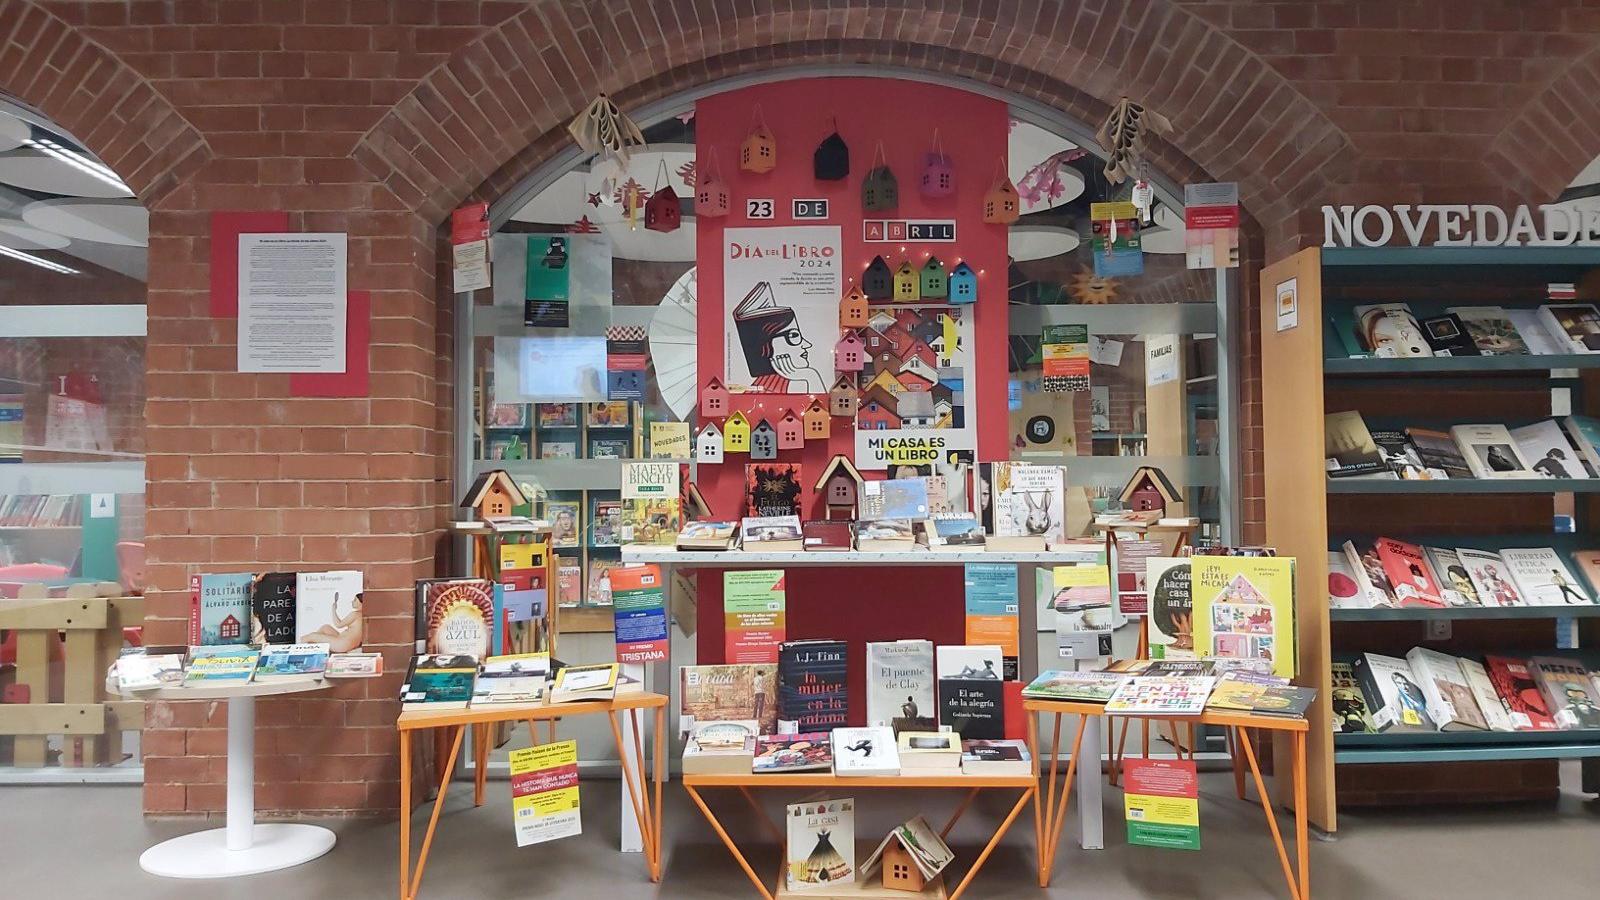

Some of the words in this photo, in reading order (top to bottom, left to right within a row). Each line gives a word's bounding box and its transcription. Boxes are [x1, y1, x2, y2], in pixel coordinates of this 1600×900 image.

[749, 202, 772, 217] 23
[798, 203, 822, 215] DE
[870, 226, 950, 238] ABRIL
[730, 243, 763, 259] DÍA
[800, 260, 831, 268] 2024
[1150, 344, 1172, 359] FAMILIAS
[654, 435, 686, 447] NOVEDADES
[868, 438, 884, 448] MI
[888, 438, 927, 448] CASA
[929, 437, 945, 448] ES
[875, 450, 894, 460] UN
[898, 450, 938, 460] LIBRO
[630, 464, 673, 474] MAEVE
[630, 473, 673, 484] BINCHY
[761, 498, 790, 506] FUEGO
[1508, 552, 1553, 560] LIBERTAD
[1163, 579, 1190, 588] hacer
[1211, 580, 1230, 588] CASA
[277, 585, 291, 594] LA
[263, 599, 294, 608] PARE
[1167, 599, 1180, 607] un
[268, 613, 282, 622] DE
[445, 630, 481, 640] AZUL
[621, 650, 665, 661] TRISTANA
[794, 652, 813, 663] A.J.
[818, 651, 840, 661] Finn
[805, 671, 816, 683] la
[881, 667, 891, 677] El
[894, 668, 925, 679] puente
[798, 680, 842, 694] mujer
[885, 679, 897, 689] de
[899, 679, 921, 691] Clay
[959, 688, 967, 697] El
[807, 700, 823, 710] en
[829, 697, 842, 709] la
[949, 697, 959, 706] de
[960, 698, 967, 707] la
[969, 699, 994, 709] alegría
[521, 777, 543, 787] HISTORIA
[558, 772, 578, 781] NUNCA
[543, 780, 570, 790] CONTADO
[808, 816, 818, 824] La
[821, 815, 839, 824] casa
